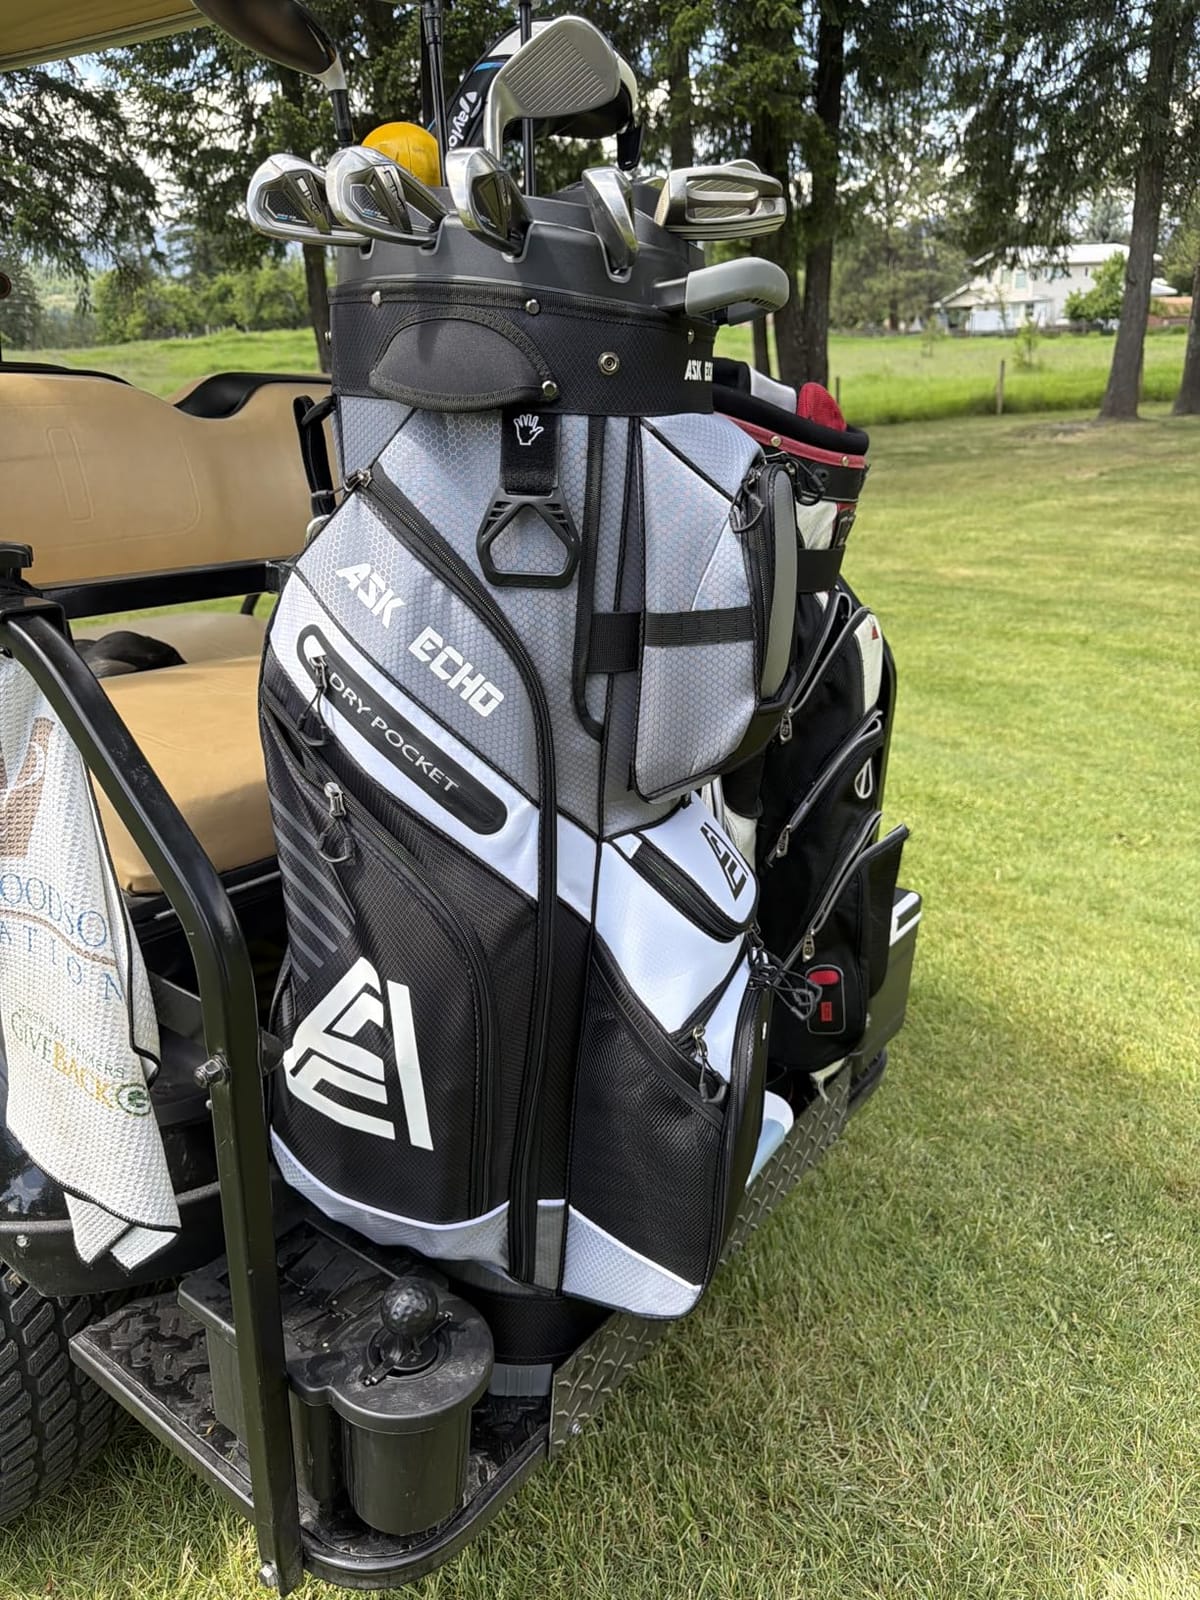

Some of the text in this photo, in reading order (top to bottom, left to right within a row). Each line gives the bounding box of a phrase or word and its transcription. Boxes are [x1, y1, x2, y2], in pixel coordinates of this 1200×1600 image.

[448, 91, 482, 150] Taylo
[684, 359, 702, 381] ASK
[335, 563, 505, 717] ASK ECHO
[329, 672, 460, 792] DRY POCKET
